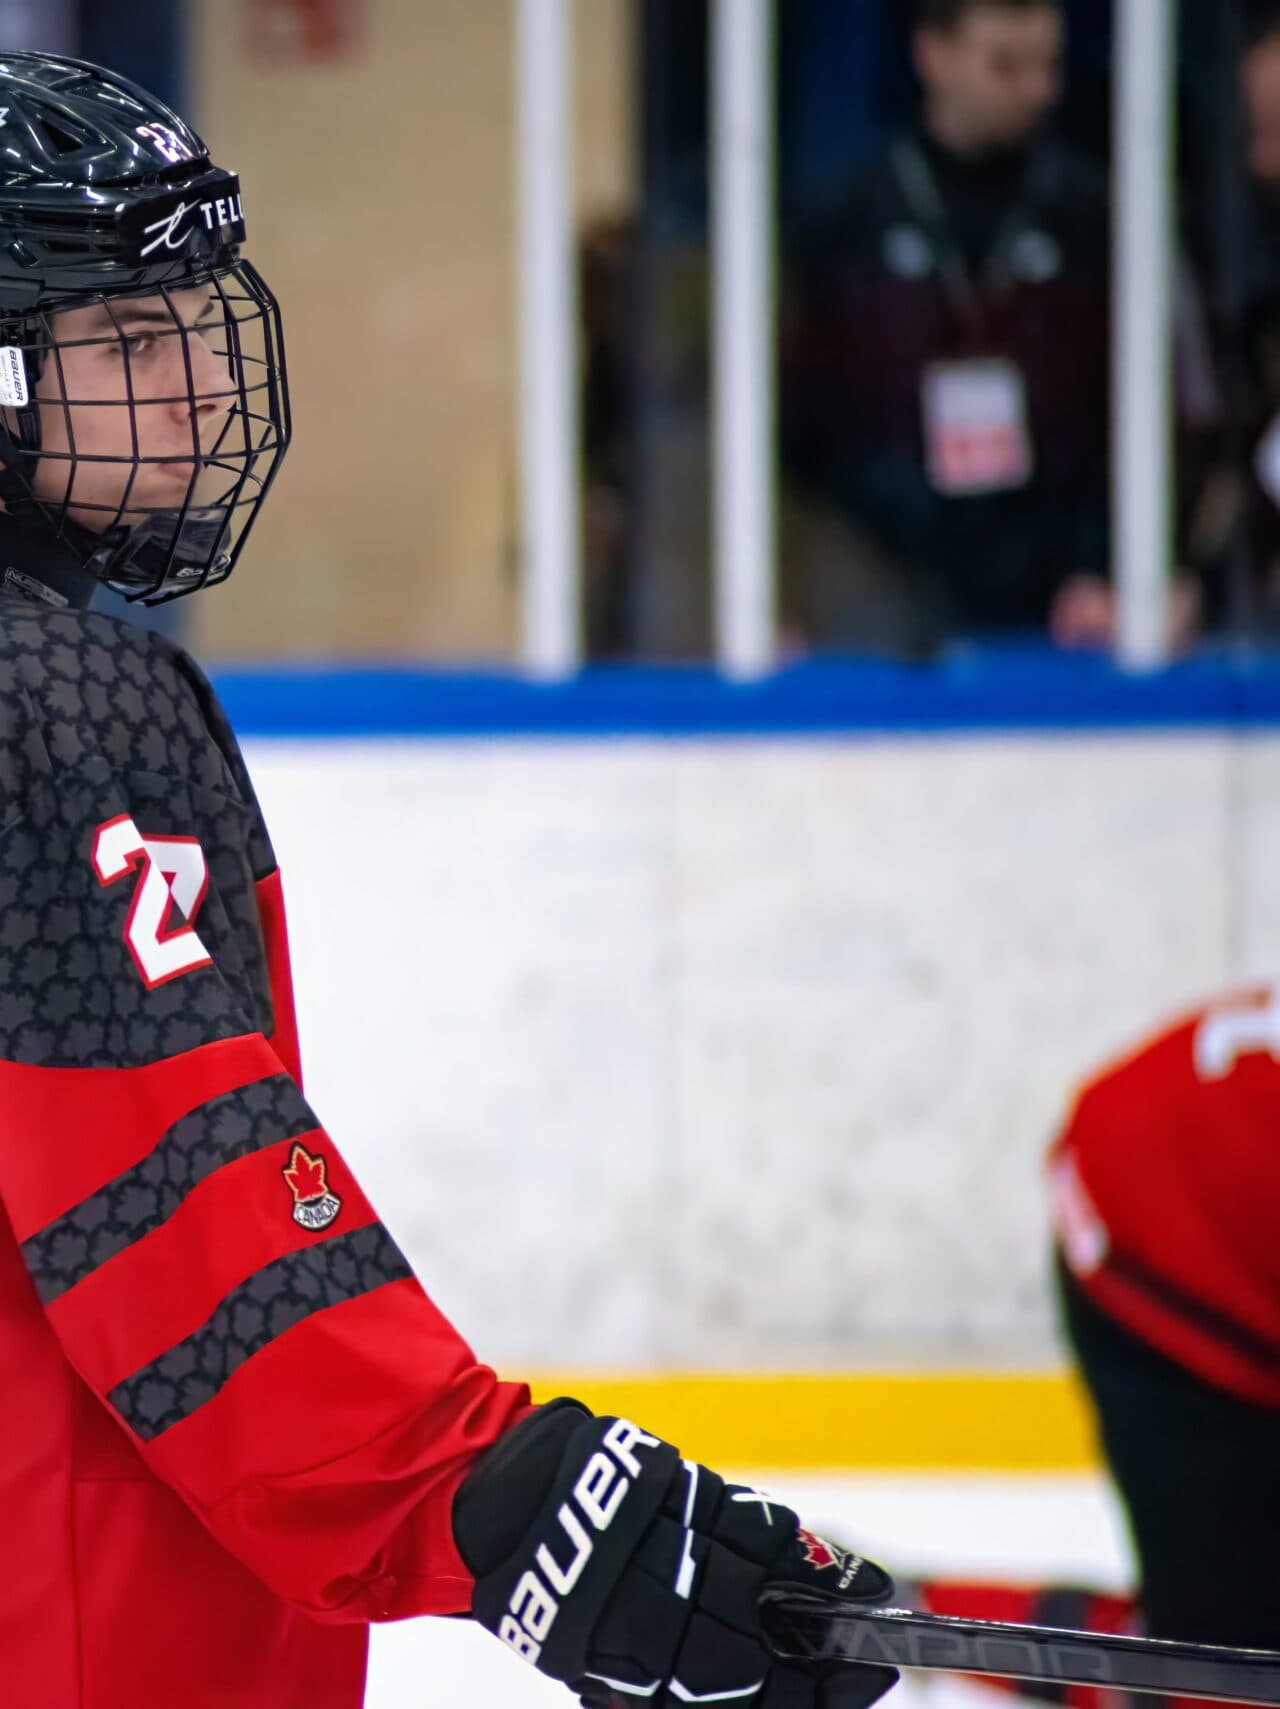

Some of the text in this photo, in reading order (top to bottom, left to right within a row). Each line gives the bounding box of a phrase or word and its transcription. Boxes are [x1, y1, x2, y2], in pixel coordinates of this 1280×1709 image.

[9, 350, 24, 401] BAUER
[297, 1197, 339, 1225] CANADA
[498, 1418, 661, 1666] BAUER
